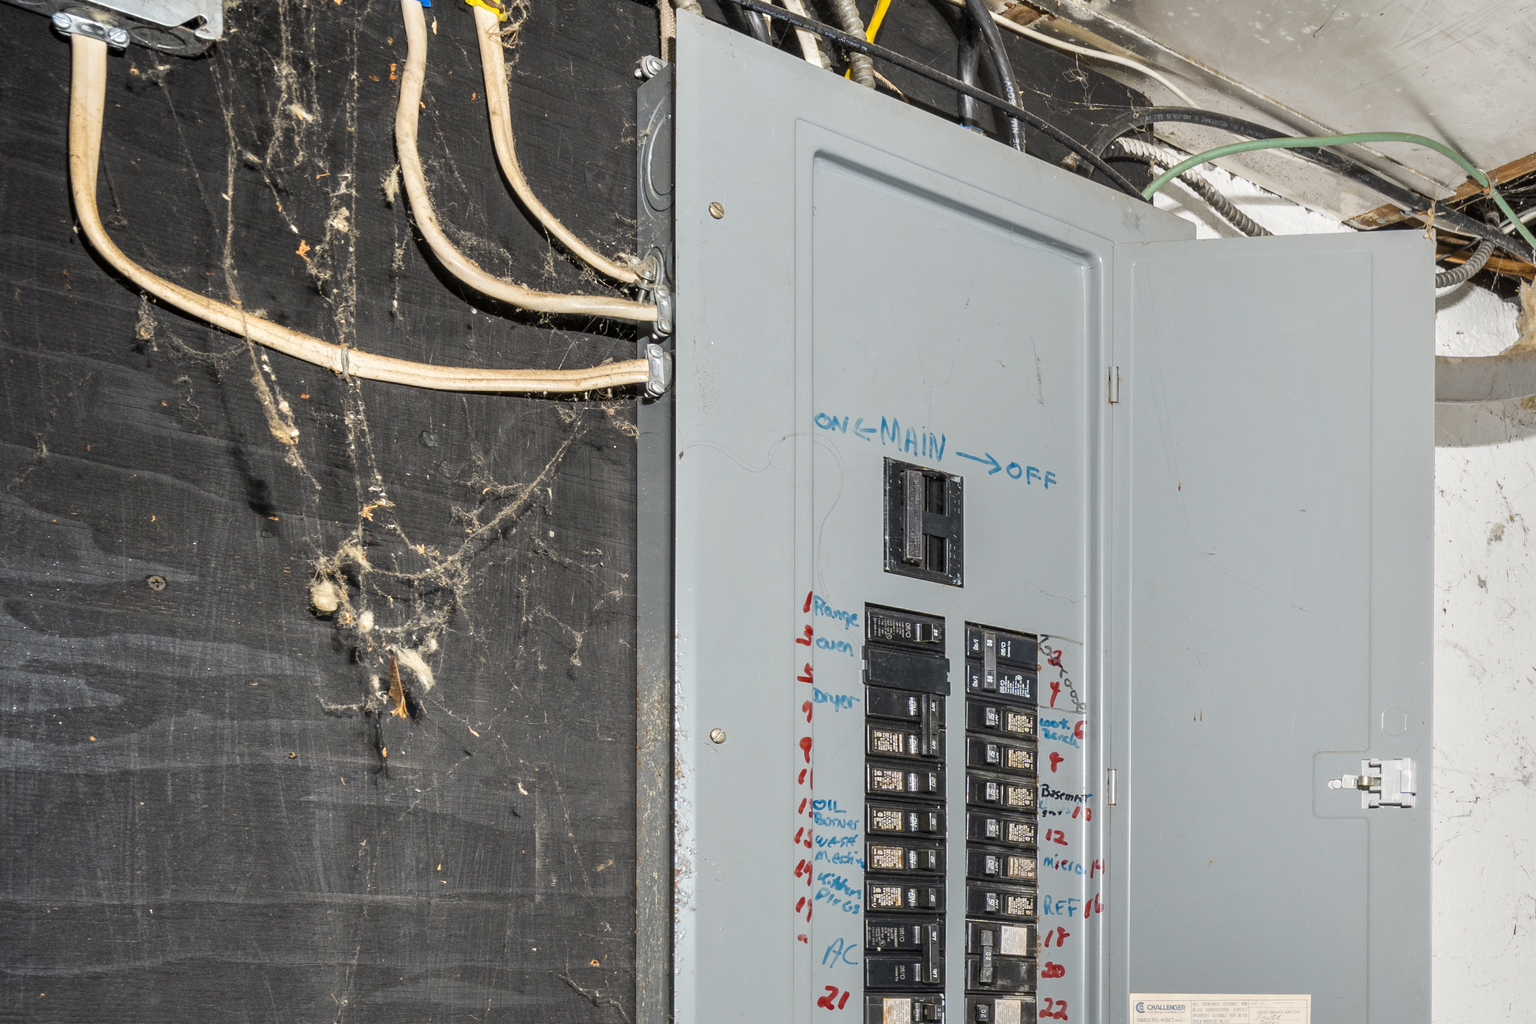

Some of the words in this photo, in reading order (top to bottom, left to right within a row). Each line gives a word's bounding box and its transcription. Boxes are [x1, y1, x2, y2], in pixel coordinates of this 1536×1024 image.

[814, 412, 849, 434] ON
[880, 415, 947, 463] MAIN
[1006, 461, 1058, 490] OFF
[813, 595, 860, 630] Range
[813, 687, 860, 713] Dryer
[813, 799, 846, 814] OIL
[1045, 828, 1069, 846] 12
[1043, 894, 1081, 918] REF
[1084, 893, 1104, 919] 16
[822, 937, 859, 969] AC
[985, 951, 991, 961] 20
[817, 985, 850, 1010] 21
[1039, 997, 1068, 1021] 22
[981, 1009, 987, 1018] 20
